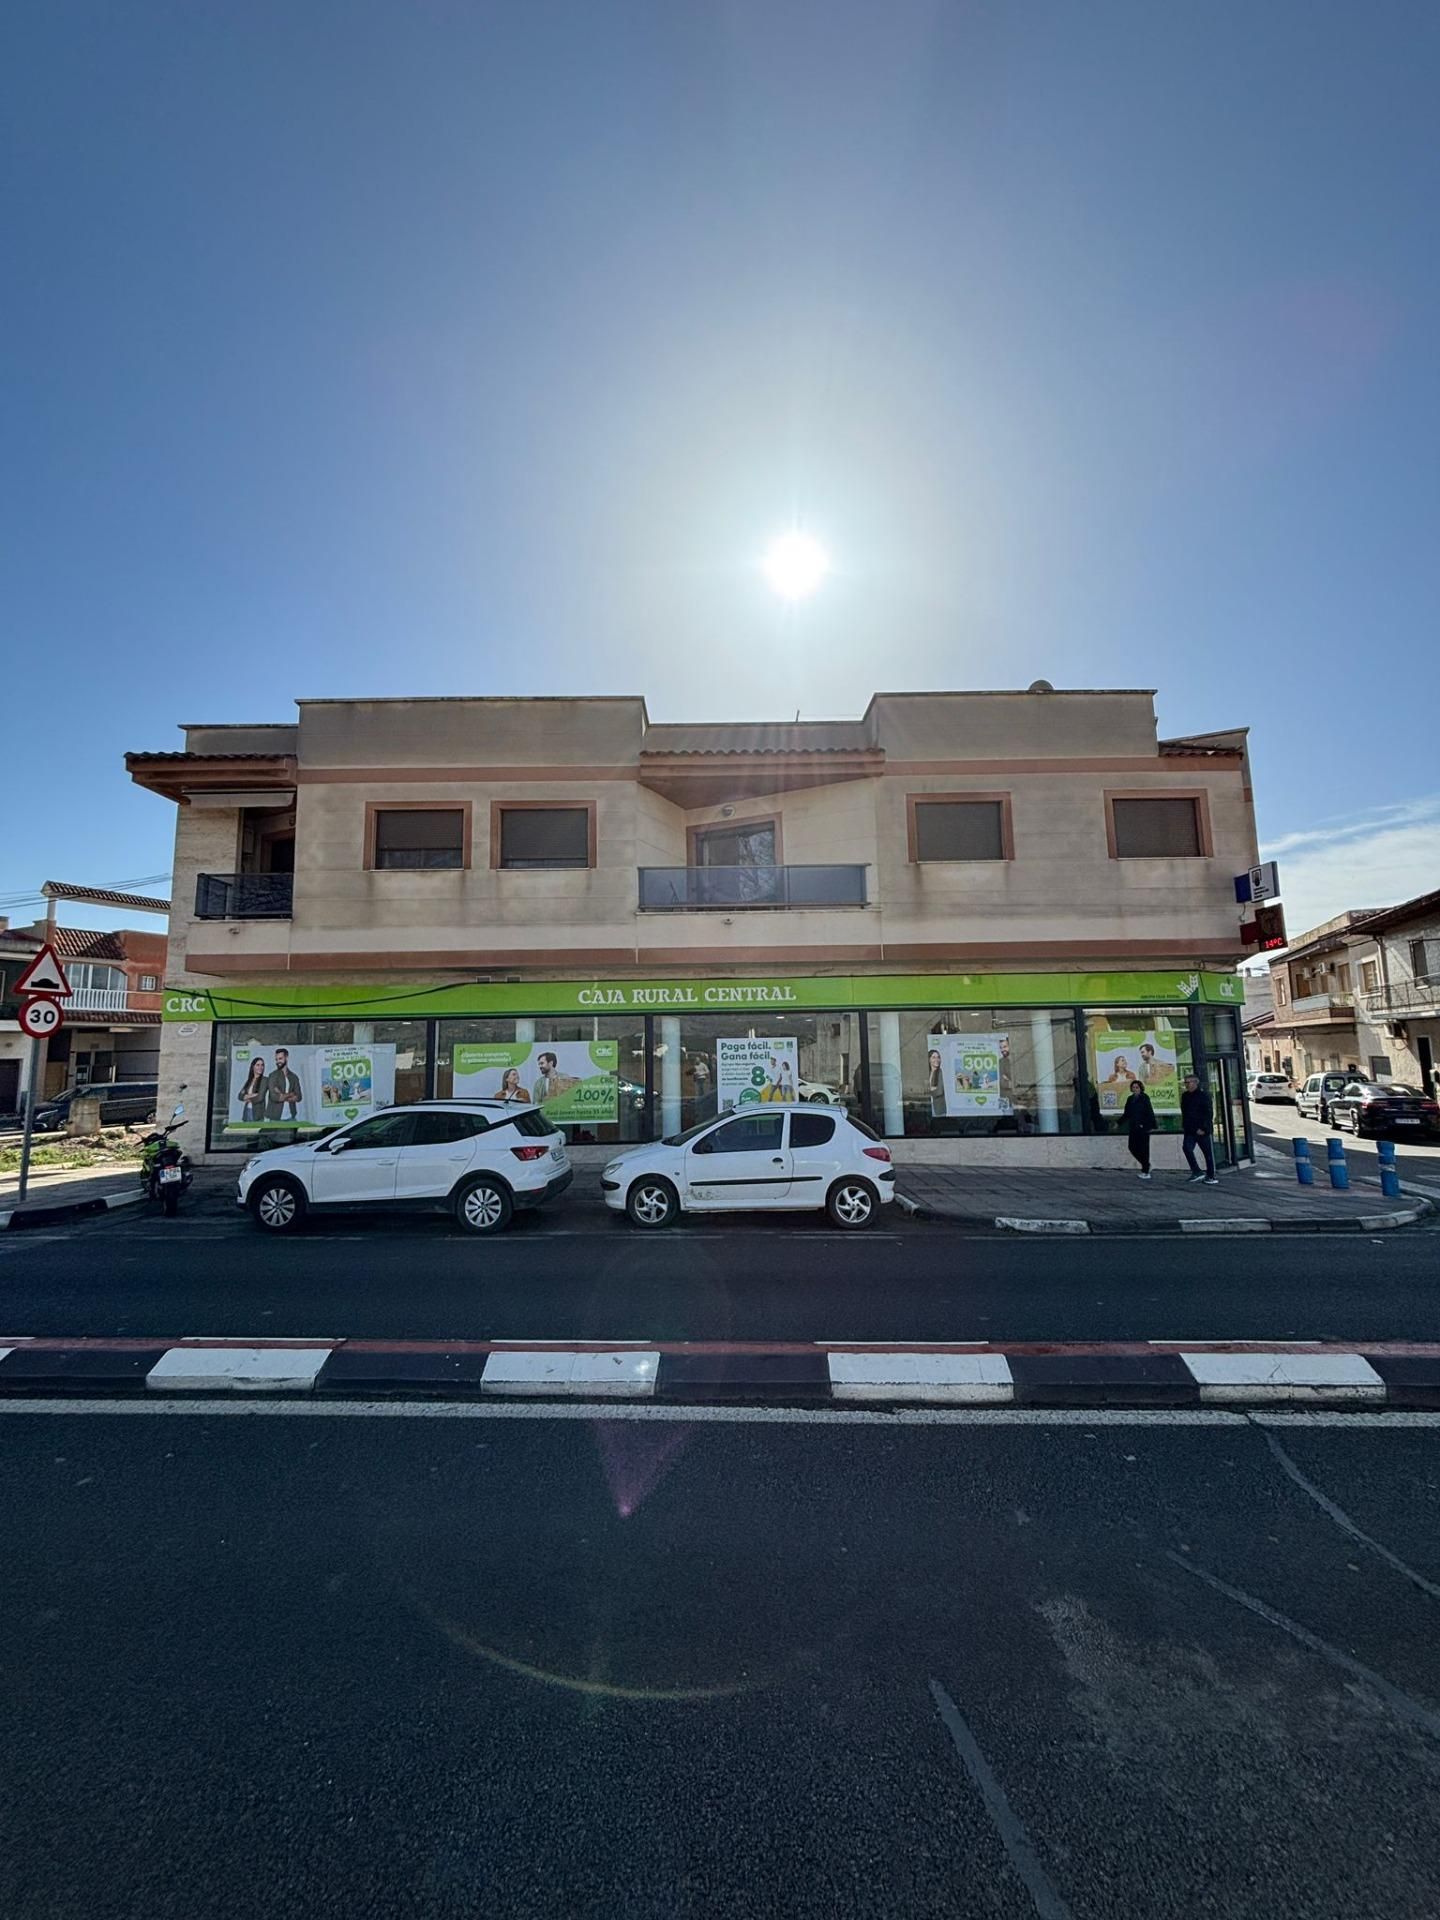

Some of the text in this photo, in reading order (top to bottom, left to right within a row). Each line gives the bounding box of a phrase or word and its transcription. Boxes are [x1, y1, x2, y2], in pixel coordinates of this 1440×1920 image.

[577, 986, 796, 1005] CAJA RURAL CENTRAL
[166, 997, 206, 1012] CRC
[29, 1009, 56, 1024] 30
[720, 1042, 746, 1052] Paga
[720, 1052, 747, 1060] Gana
[574, 1088, 615, 1104] 100%
